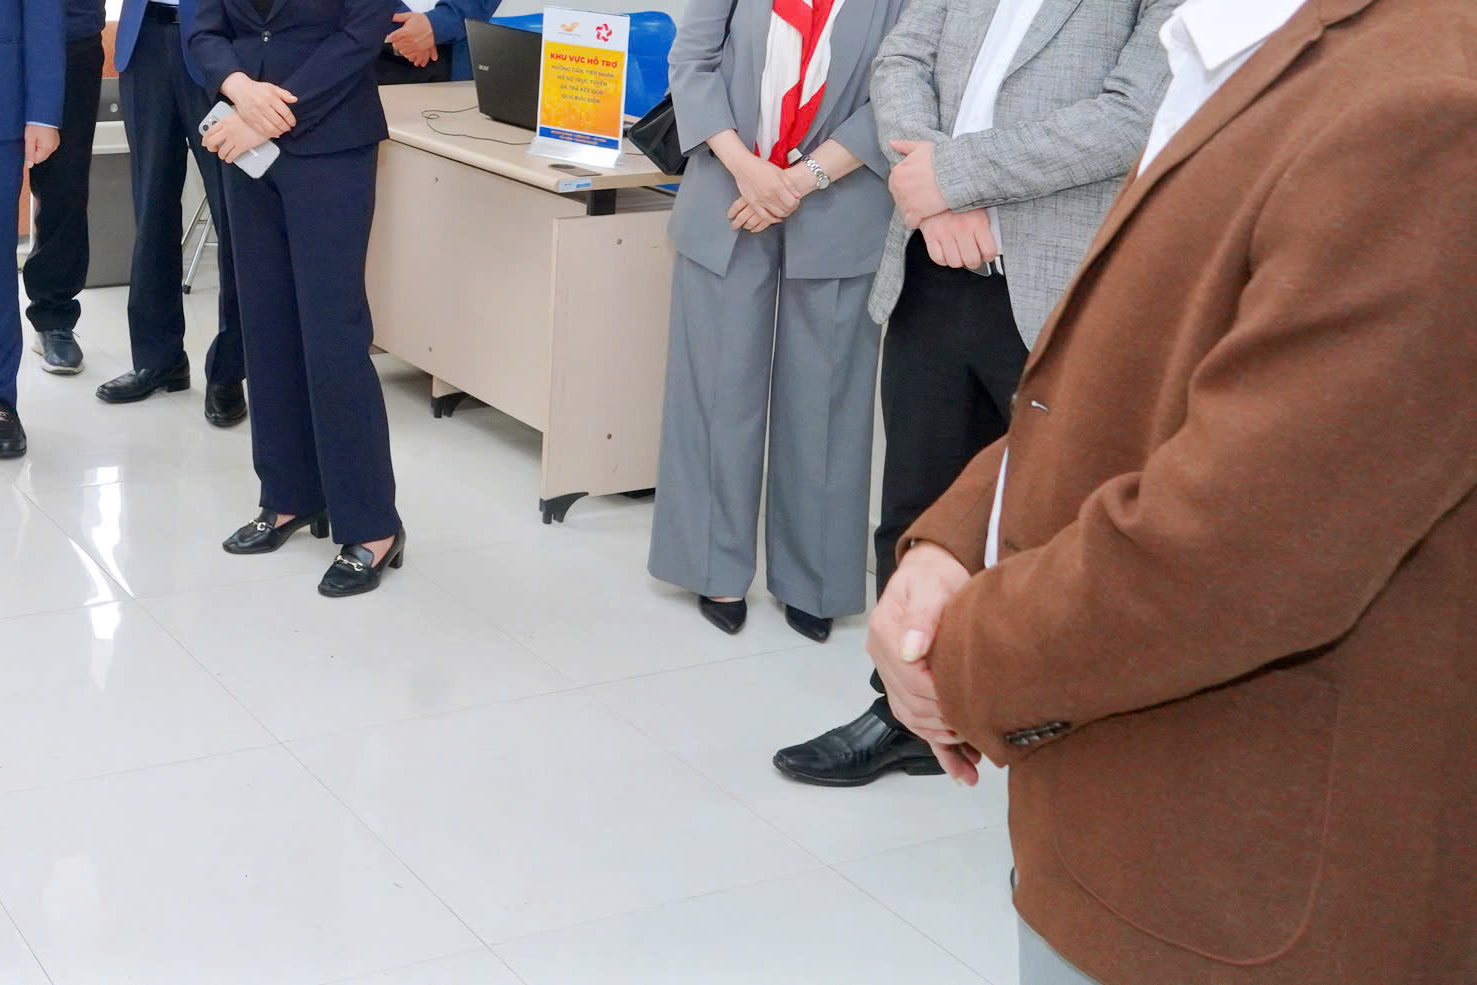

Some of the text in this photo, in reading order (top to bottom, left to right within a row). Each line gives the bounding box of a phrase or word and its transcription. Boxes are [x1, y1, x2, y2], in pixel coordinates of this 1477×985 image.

[550, 52, 618, 68] KHU VỰC HỖ TRỢ
